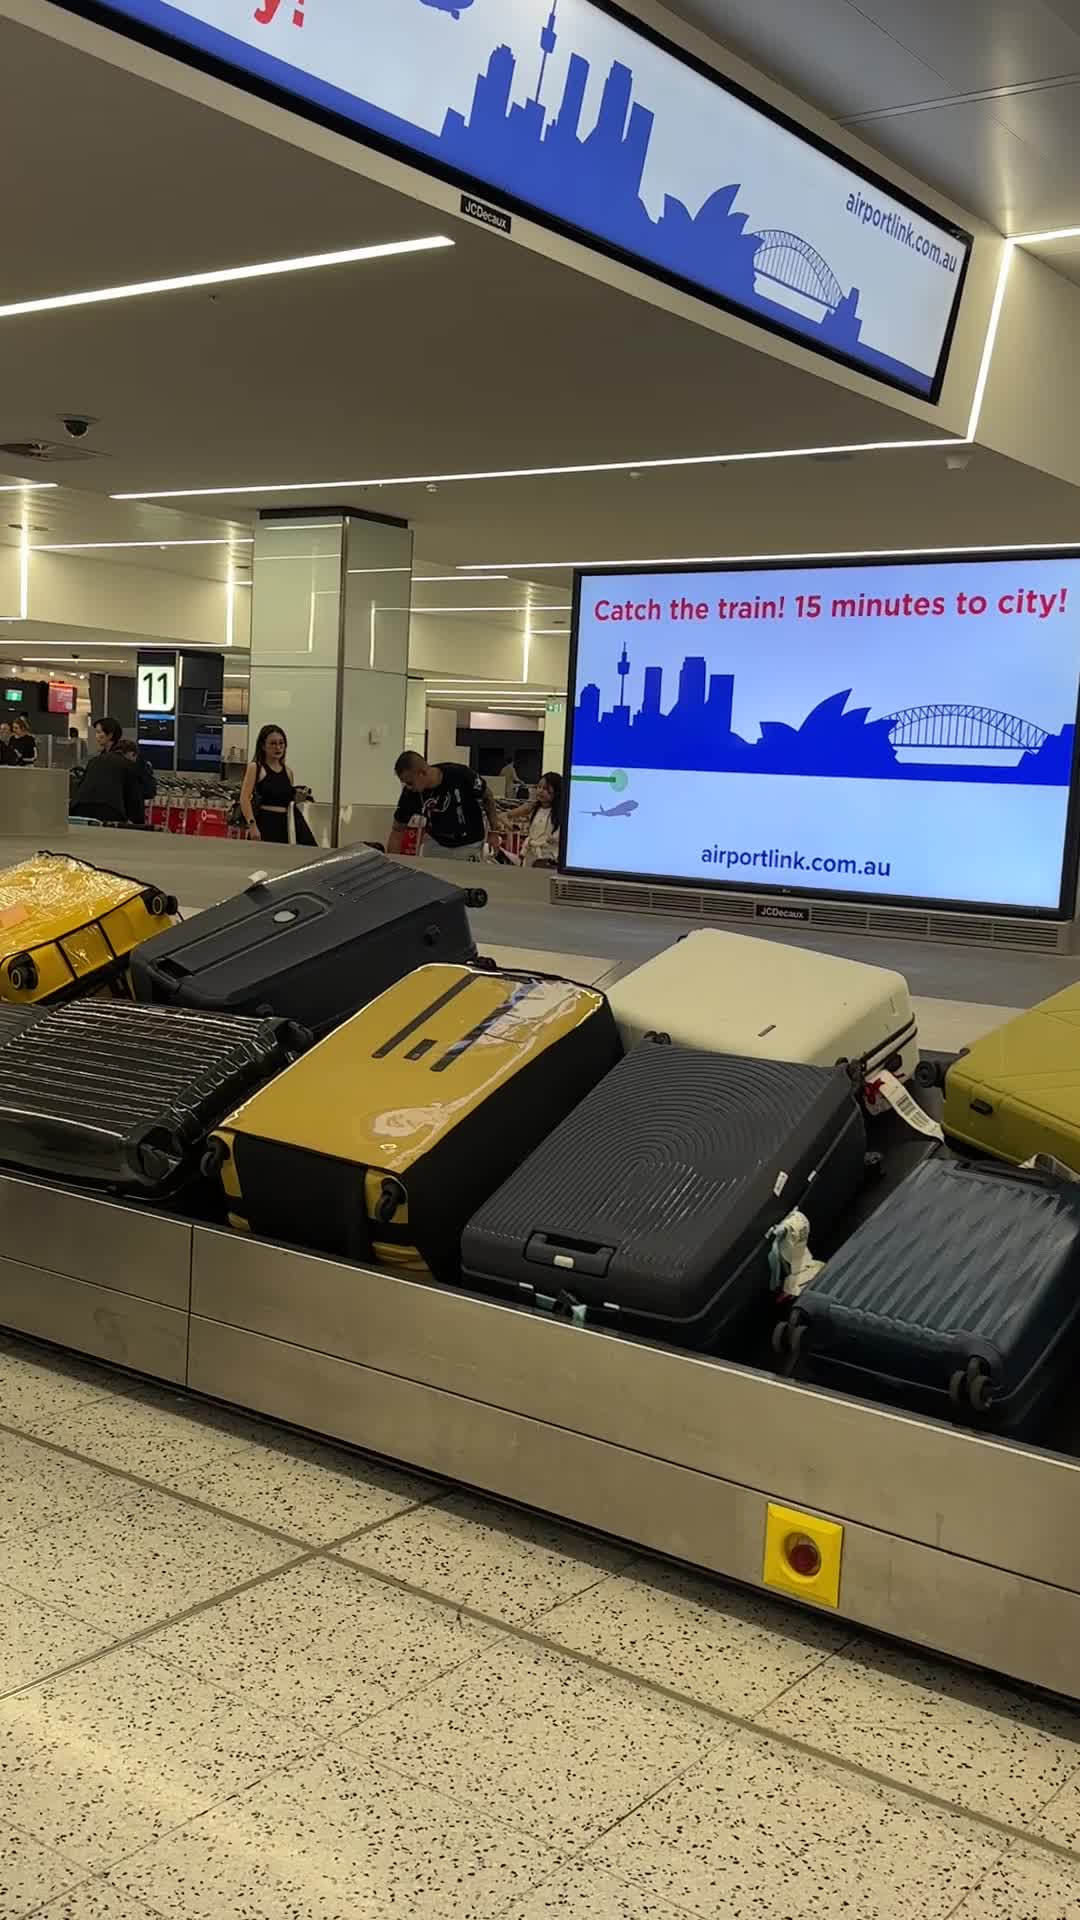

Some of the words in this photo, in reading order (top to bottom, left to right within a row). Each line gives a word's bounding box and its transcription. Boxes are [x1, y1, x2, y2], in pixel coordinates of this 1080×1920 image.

[465, 200, 507, 230] JCDecaux
[846, 192, 957, 273] airportlink.com.au
[594, 599, 661, 621] Catch
[670, 598, 709, 620] the
[718, 596, 785, 619] train!
[795, 595, 821, 618] 15
[831, 593, 945, 617] minutes
[957, 592, 987, 615] to
[998, 588, 1067, 618] city!
[143, 672, 168, 705] 11
[701, 844, 891, 877] airportlink.com.au
[760, 906, 804, 919] JCDecaux
